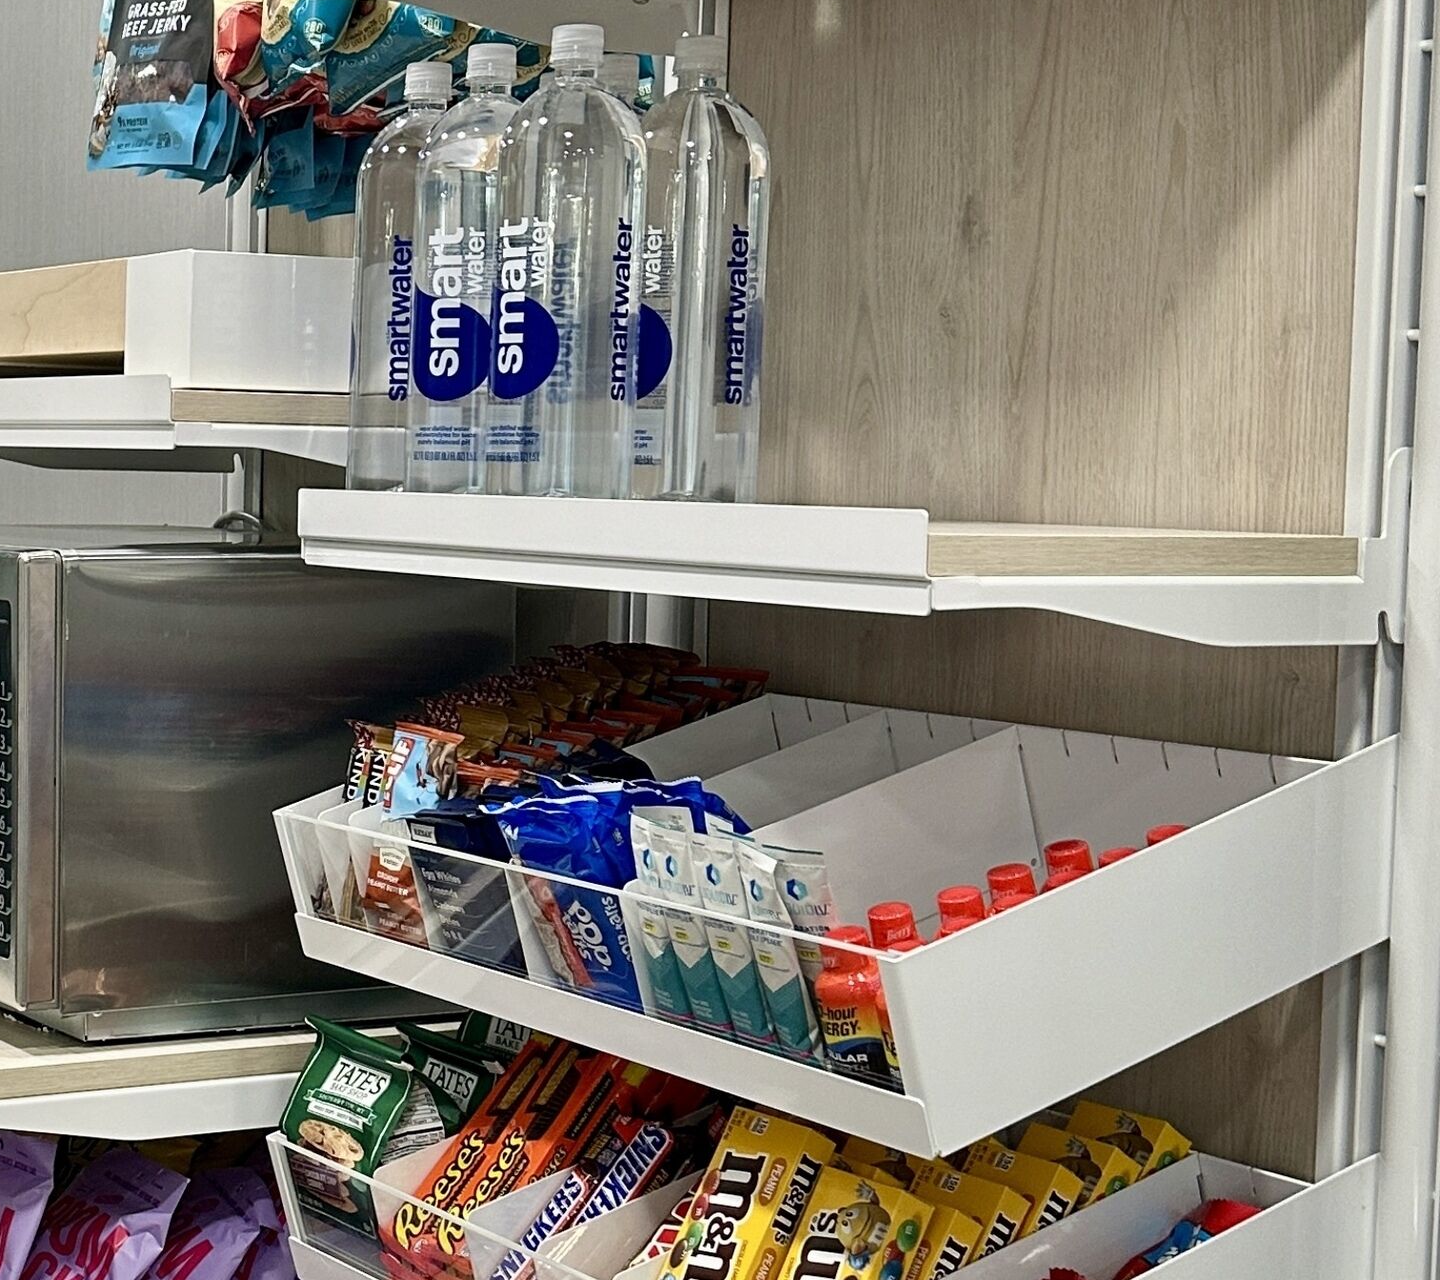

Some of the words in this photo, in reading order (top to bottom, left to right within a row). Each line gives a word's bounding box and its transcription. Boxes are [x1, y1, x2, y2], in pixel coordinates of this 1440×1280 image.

[122, 21, 147, 40] BEEF
[148, 14, 192, 36] JERKY
[305, 21, 324, 34] 280
[421, 16, 442, 29] 280
[126, 117, 149, 126] PROTEIN
[466, 226, 488, 294] water
[528, 216, 554, 288] water
[643, 225, 664, 294] water
[429, 227, 465, 378] smart
[497, 216, 530, 375] smart
[609, 216, 634, 402] smartwater
[387, 234, 413, 402] smartwater
[724, 223, 750, 405] smartwater
[0, 681, 6, 697] 1
[0, 708, 7, 724] 2
[0, 734, 6, 750] 3
[0, 761, 6, 777] 4
[345, 746, 368, 800] KIND
[366, 749, 388, 804] KIND
[0, 788, 6, 804] 5
[0, 815, 6, 831] 6
[0, 842, 5, 857] 7
[422, 867, 437, 881] Egg
[437, 870, 461, 885] Whites
[887, 926, 911, 942] Berry
[495, 1036, 521, 1051] BAKE
[825, 1020, 860, 1037] ERGY
[331, 1061, 388, 1099] TATE'S
[394, 1127, 488, 1251] Reese's
[436, 1126, 528, 1256] Reese's
[761, 1163, 785, 1202] PEANUT
[771, 1153, 824, 1246] m&m's
